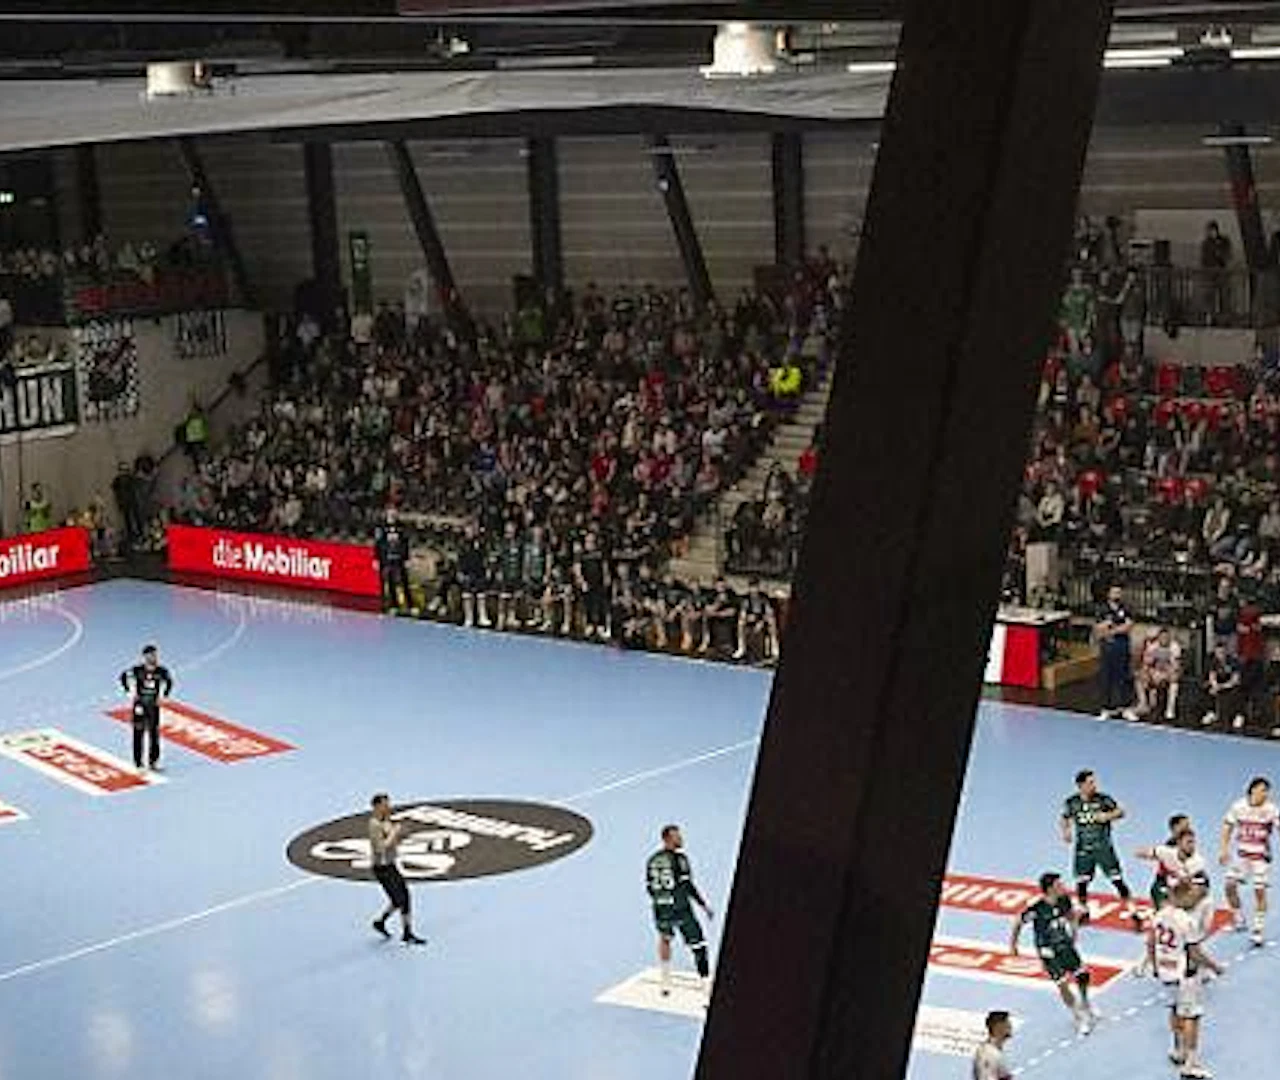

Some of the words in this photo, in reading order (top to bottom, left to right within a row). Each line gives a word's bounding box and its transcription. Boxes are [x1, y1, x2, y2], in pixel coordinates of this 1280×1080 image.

[212, 538, 243, 568] die
[243, 543, 330, 580] Mobiliar
[1156, 923, 1177, 948] 22
